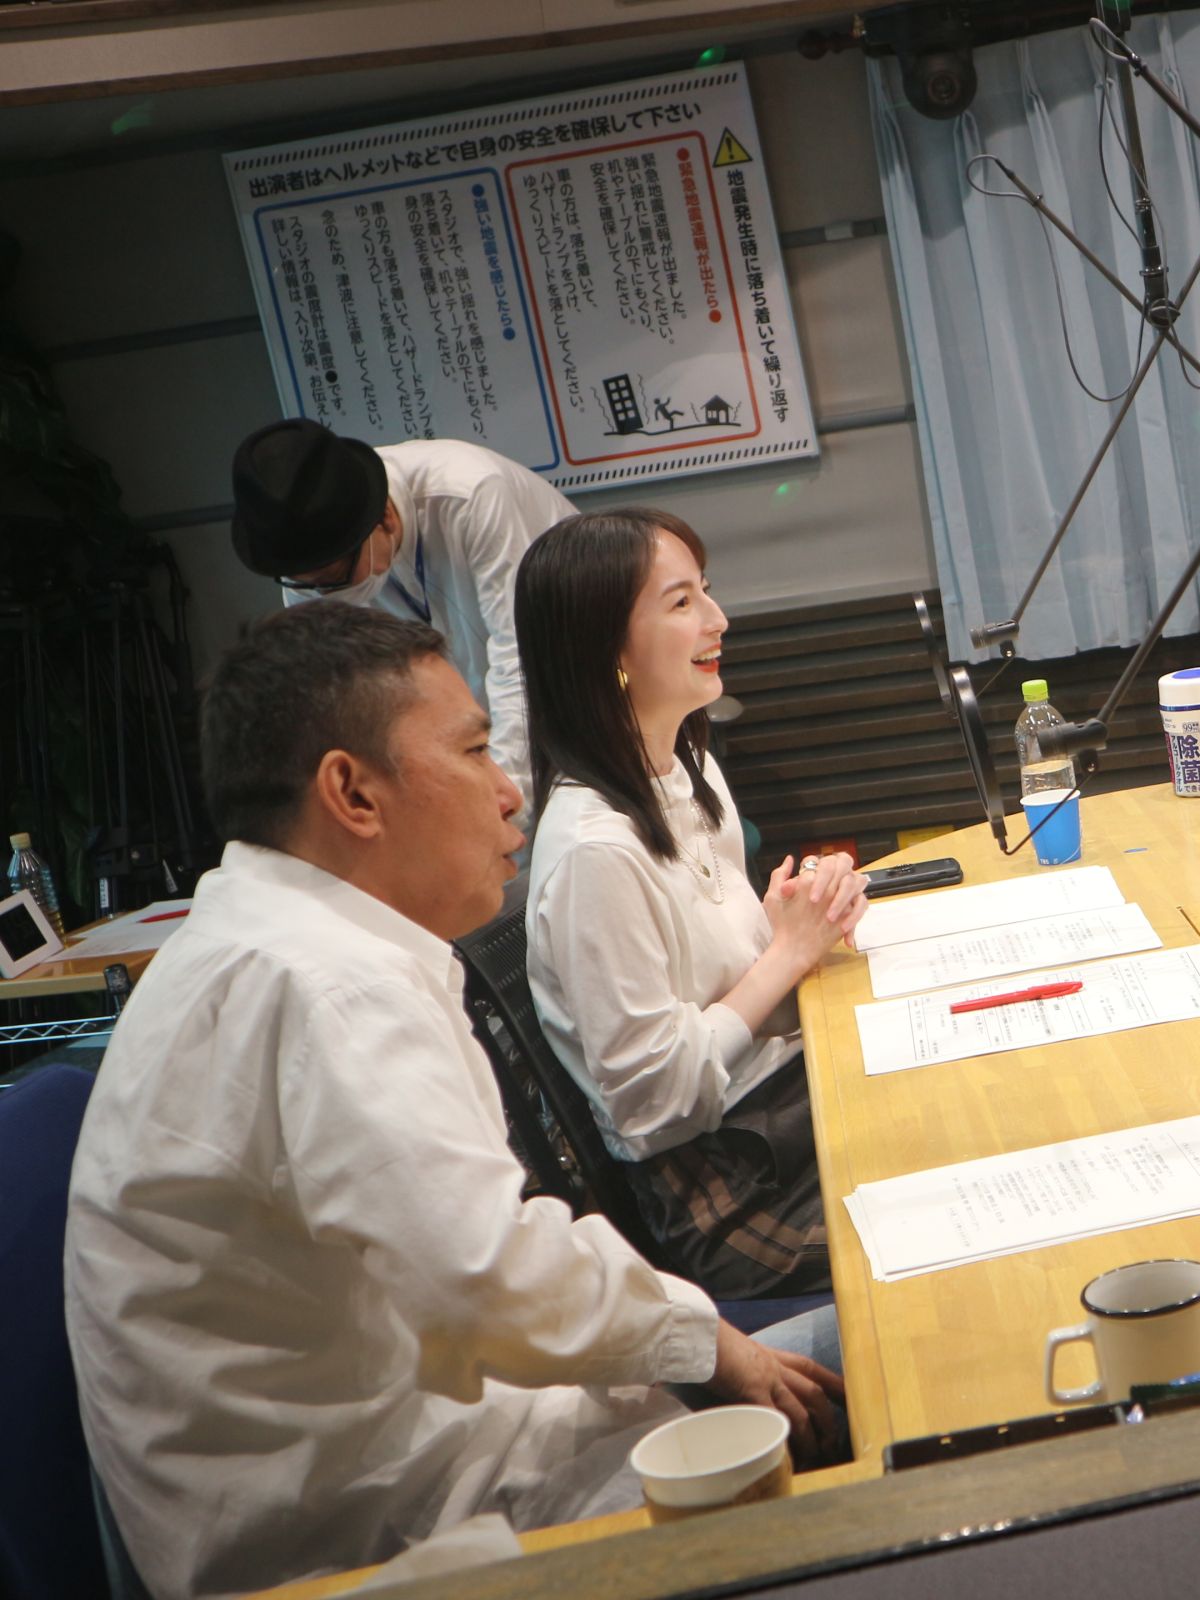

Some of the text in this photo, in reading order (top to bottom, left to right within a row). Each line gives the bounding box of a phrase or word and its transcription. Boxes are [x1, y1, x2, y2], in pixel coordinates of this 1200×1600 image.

[248, 101, 702, 199] 出演者はヘルメットなどで自身の安全を確保して下さい
[727, 169, 789, 423] 地震発生時に落ち着いて繰り返す
